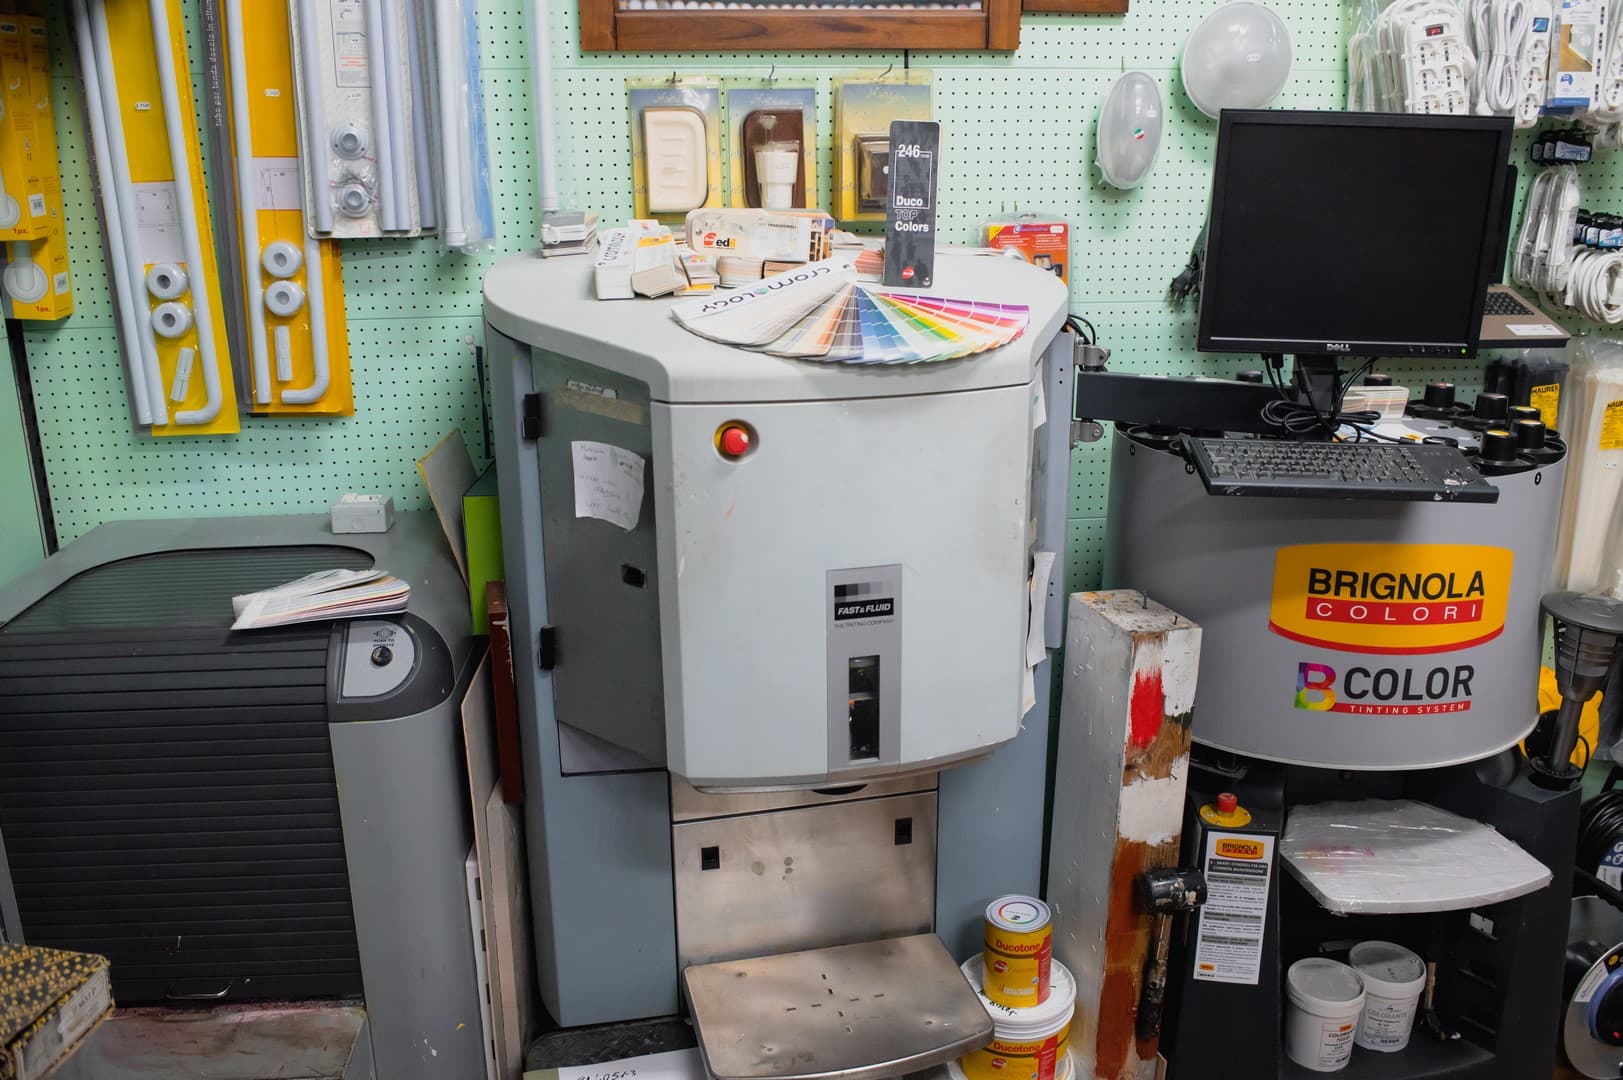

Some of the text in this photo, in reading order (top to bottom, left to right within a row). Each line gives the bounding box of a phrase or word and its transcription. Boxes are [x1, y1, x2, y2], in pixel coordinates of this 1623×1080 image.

[898, 144, 920, 158] 246
[896, 195, 924, 207] Duco
[895, 209, 919, 221] TOP
[895, 221, 930, 233] Colors
[1326, 343, 1351, 351] DELL
[1307, 567, 1485, 601] BRIGNOLA
[1316, 602, 1476, 622] COLORI
[1294, 661, 1475, 712] B COLOR
[1350, 702, 1465, 714] TINTING SYSTEM
[1222, 842, 1258, 851] BRIGNOLA
[995, 938, 1041, 952] Ducotone
[993, 1039, 1042, 1054] Ducotone
